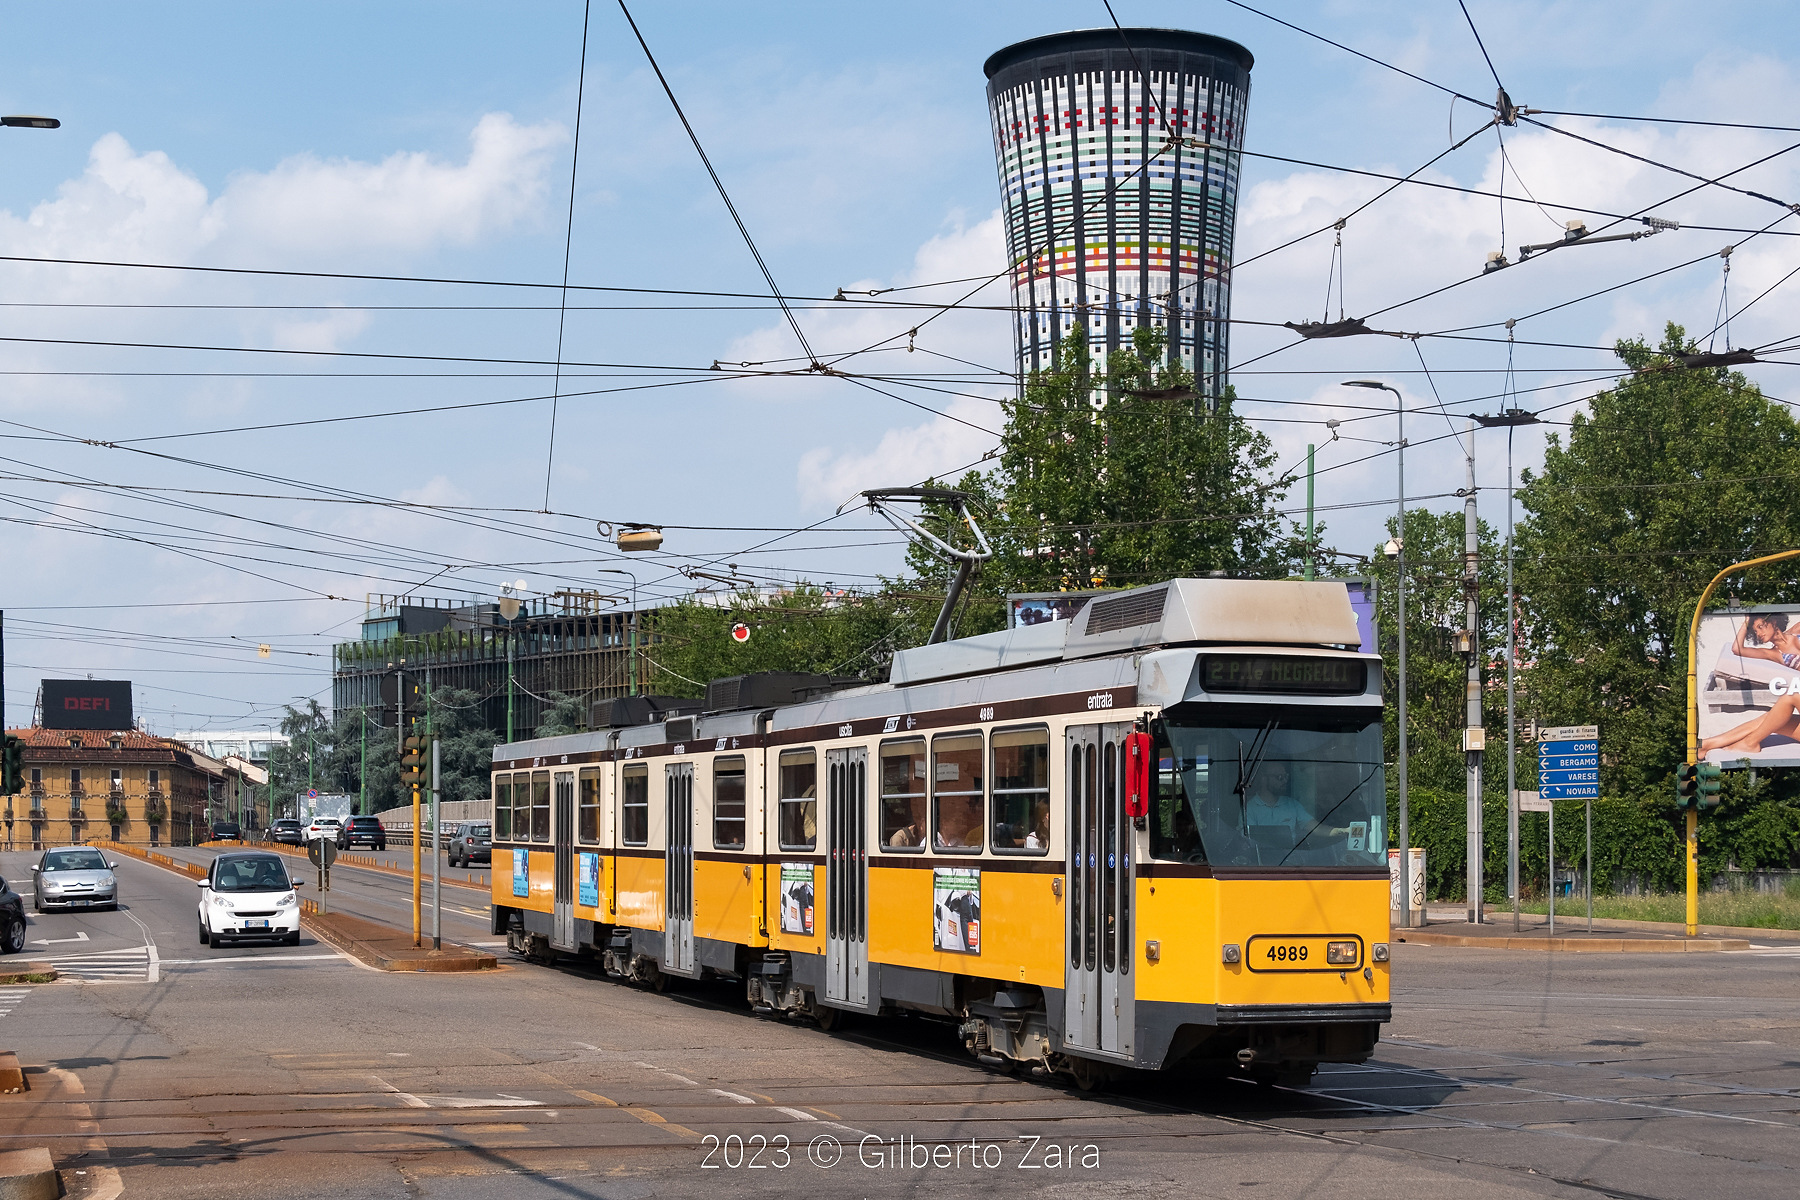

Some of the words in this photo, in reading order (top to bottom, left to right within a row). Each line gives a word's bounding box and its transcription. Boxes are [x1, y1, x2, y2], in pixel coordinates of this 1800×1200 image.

[1211, 661, 1224, 680] 2
[1271, 661, 1348, 682] NEGRELLI
[1769, 676, 1800, 696] CA
[64, 697, 110, 711] DEFI
[1087, 691, 1113, 709] entrata
[979, 706, 994, 721] 4989
[838, 723, 853, 737] uscita
[1574, 743, 1597, 751] COMO
[1560, 758, 1597, 767] BERGAMO
[1568, 773, 1597, 781] VARESE
[1566, 787, 1597, 795] NOVARA
[1353, 839, 1359, 848] 2
[1266, 945, 1308, 962] 4989
